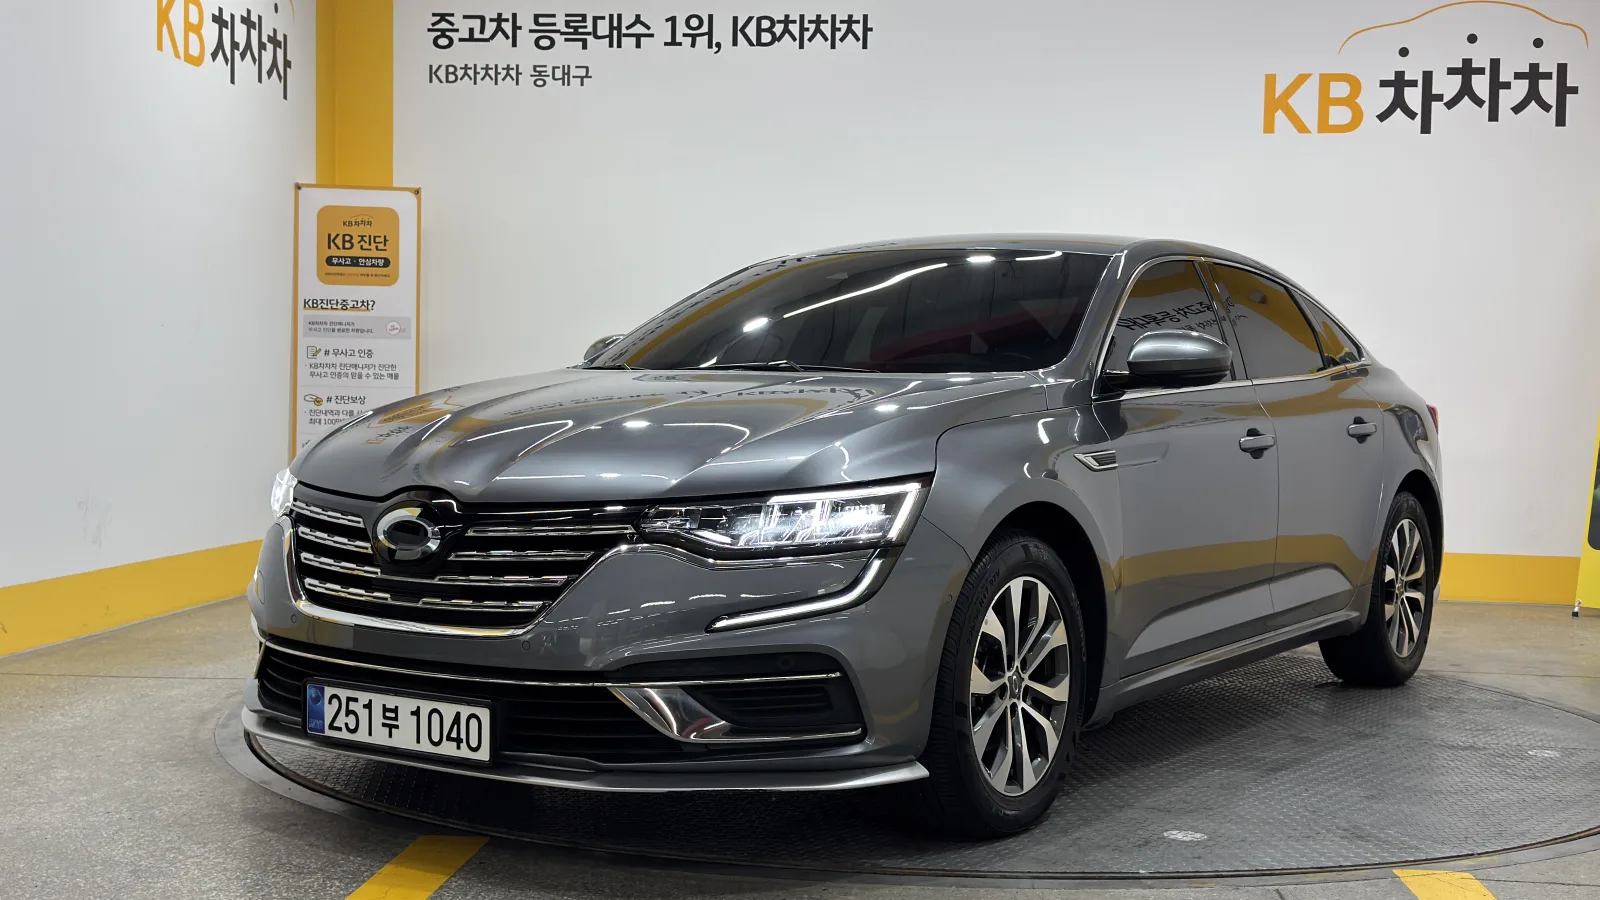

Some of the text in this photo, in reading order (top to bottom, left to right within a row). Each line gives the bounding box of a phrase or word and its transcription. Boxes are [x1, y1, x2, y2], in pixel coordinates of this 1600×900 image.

[427, 12, 873, 54] 중고차 등록대수 1위, KB차차차
[156, 0, 292, 100] KB 차차차
[428, 63, 592, 87] KB차차차 동대구
[1262, 57, 1579, 135] KB 차차차
[327, 233, 389, 252] KB 진단
[331, 257, 385, 267] 무사고 안심차량
[303, 298, 376, 311] KB진단중고차?
[331, 349, 356, 358] 무사고
[357, 349, 374, 359] 인증
[309, 362, 397, 372] KB차차차 진단매니저가 진단한
[309, 371, 328, 379] 무사고
[329, 371, 349, 380] 인증의
[364, 372, 371, 380] 수
[372, 372, 386, 380] 있는
[334, 395, 366, 405] 진단보상
[327, 693, 483, 753] 251부 1040
